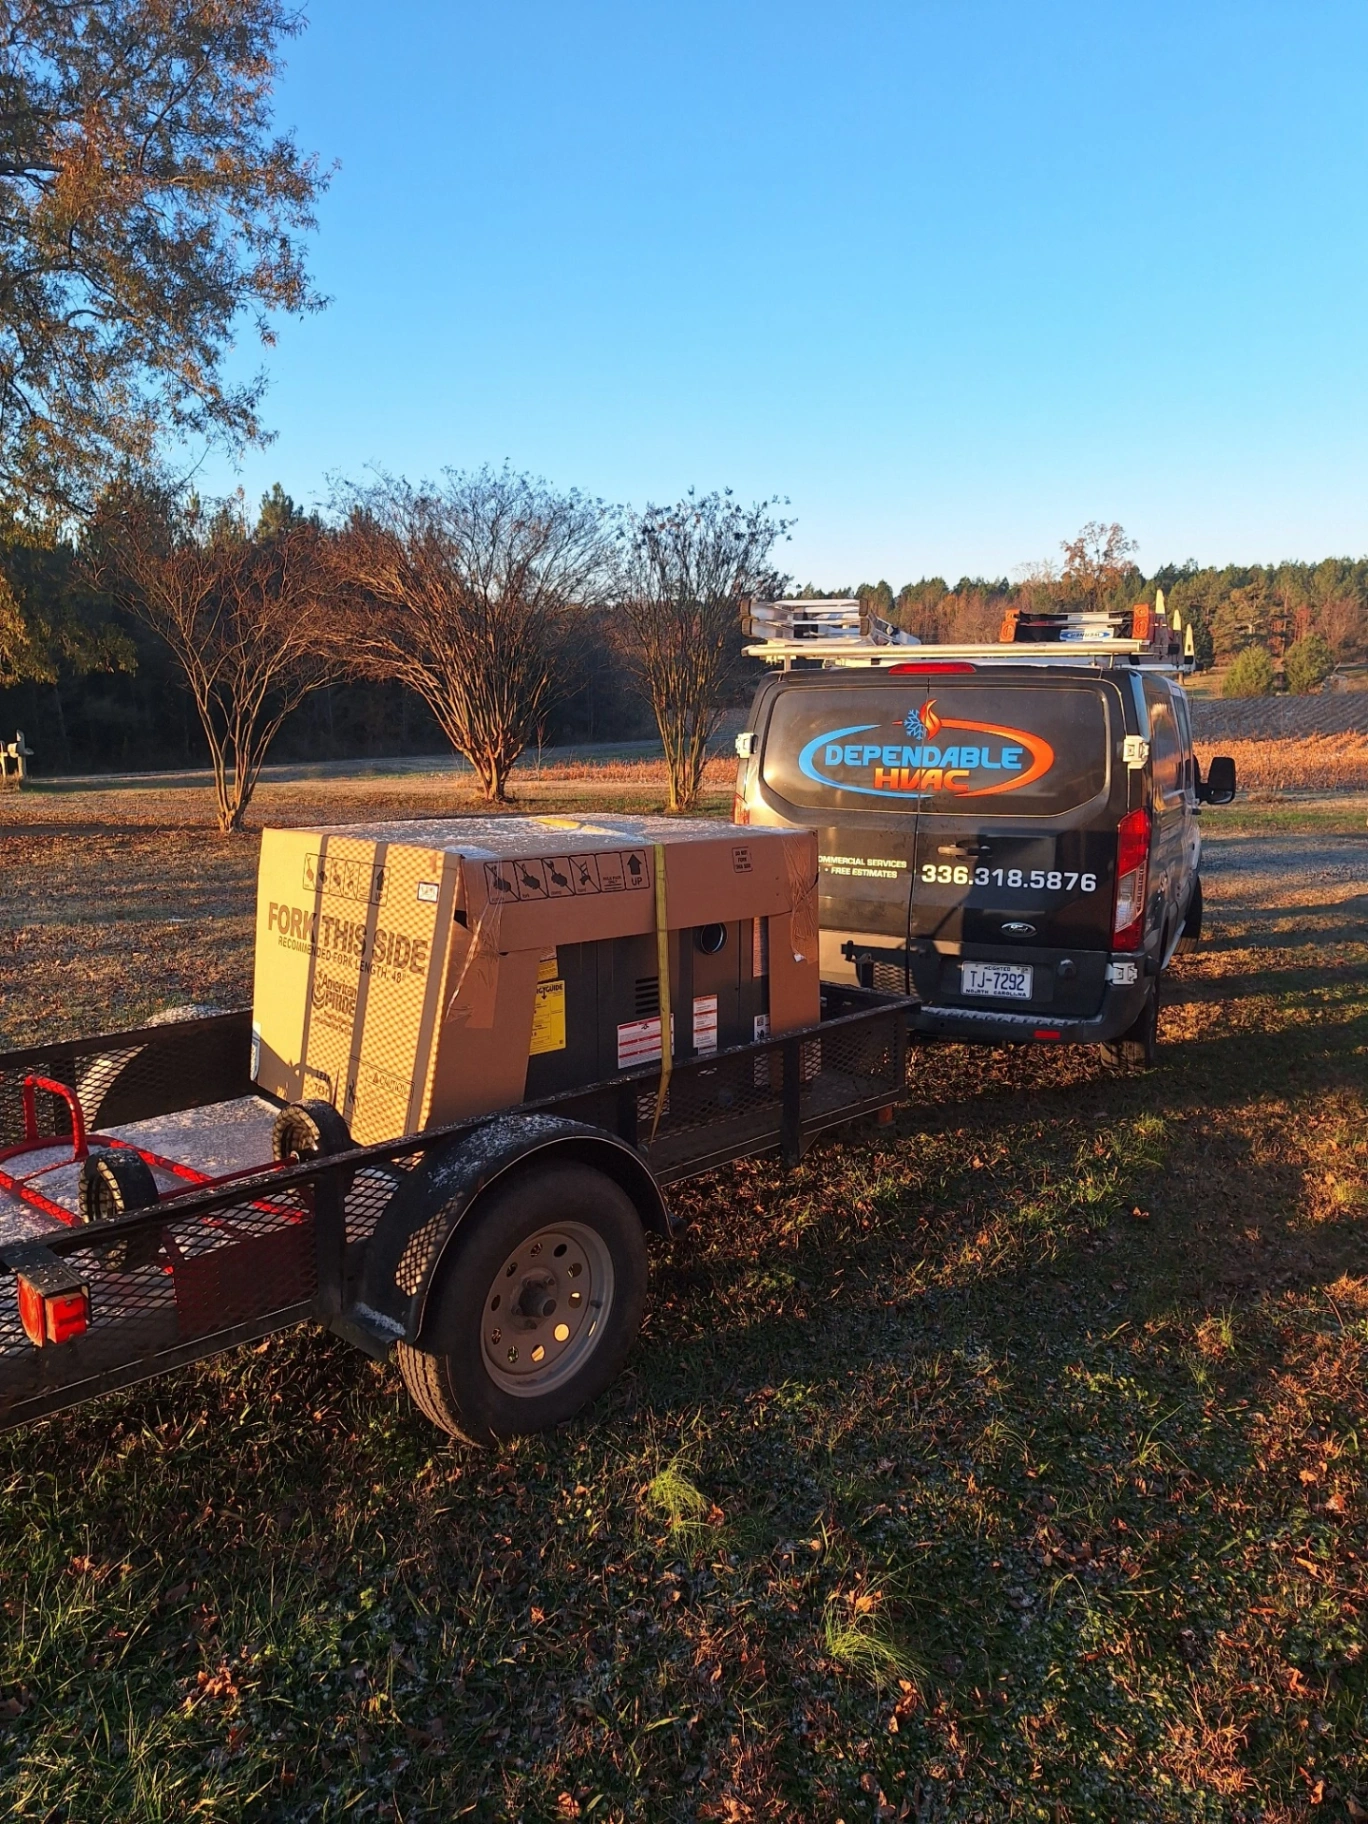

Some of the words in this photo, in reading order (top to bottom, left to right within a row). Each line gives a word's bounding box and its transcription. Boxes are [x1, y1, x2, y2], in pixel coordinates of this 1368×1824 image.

[824, 745, 1024, 770] DEPENDABLE
[873, 767, 970, 791] HVAC
[818, 855, 866, 867] OMMERCIAL
[867, 858, 908, 869] SERVICES
[831, 866, 851, 876] FREE
[851, 867, 898, 879] ESTIMATES
[631, 876, 643, 887] UP
[921, 864, 1097, 892] 336.318.5876
[267, 901, 318, 944] FORK
[321, 915, 368, 958] THIS
[372, 928, 428, 975] SIDE
[278, 935, 332, 962] RECOMMENDED
[333, 951, 354, 970] FORK
[970, 970, 1025, 991] TJ-7292
[314, 1083, 329, 1098] TEST
